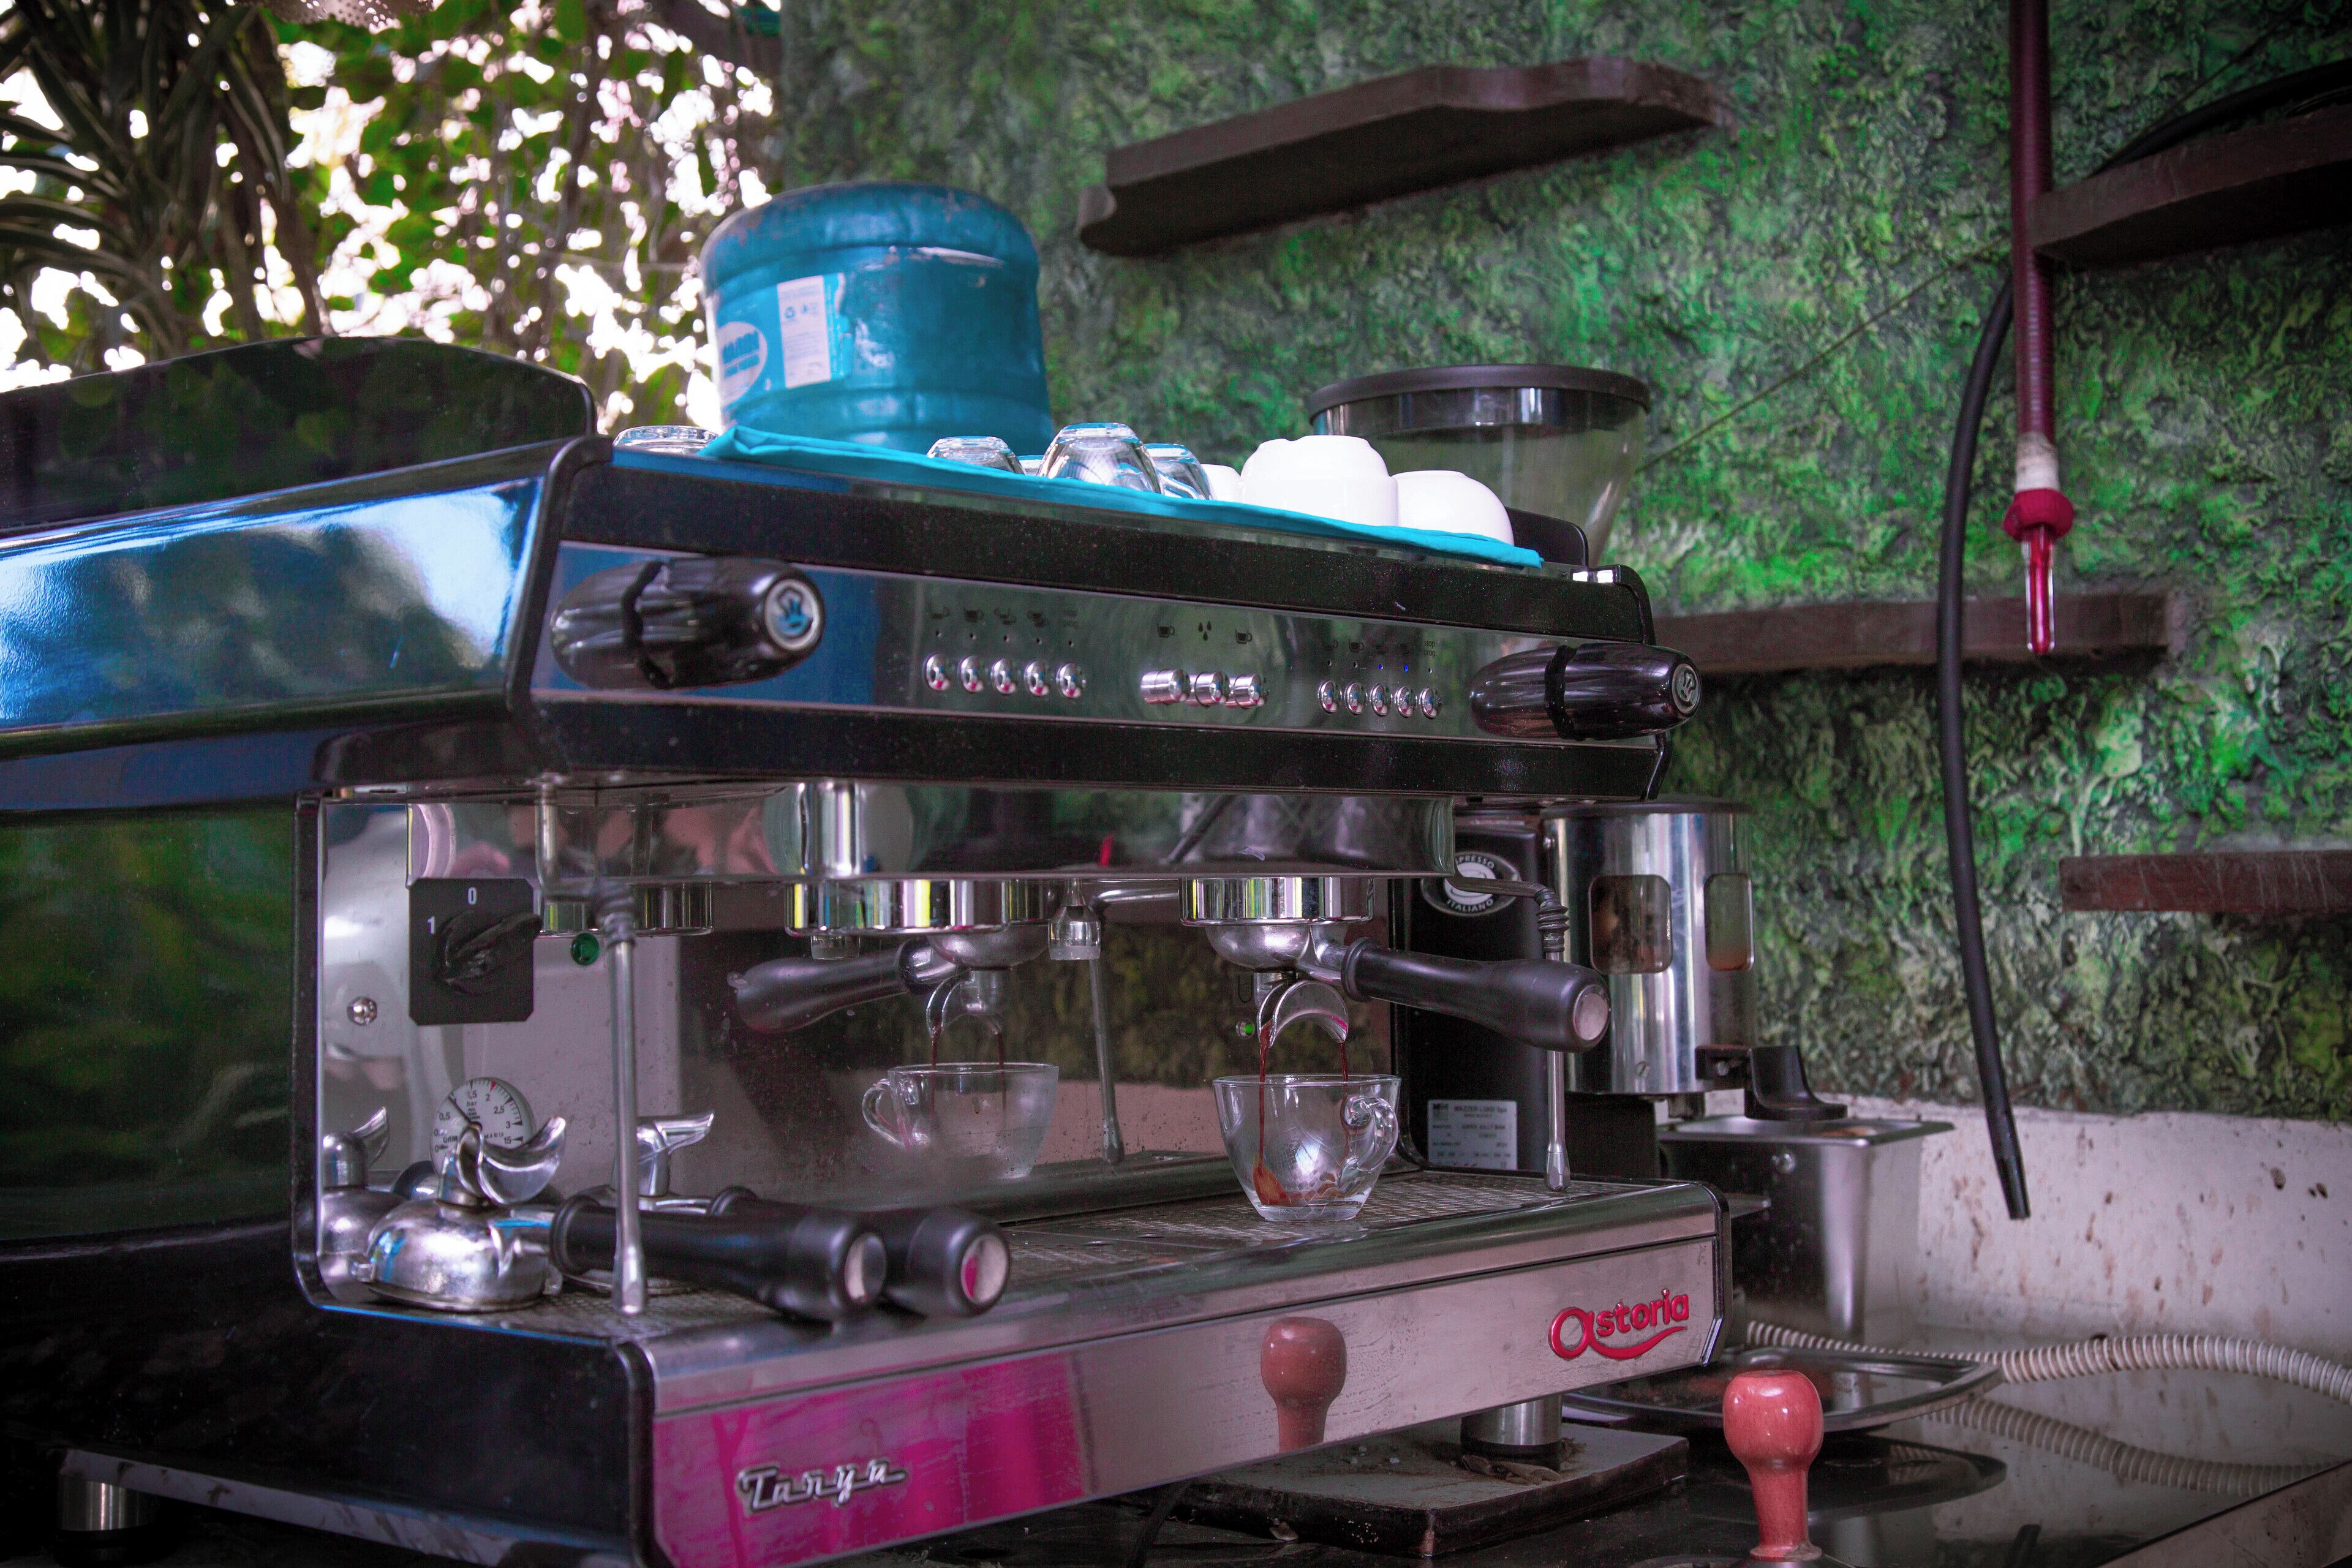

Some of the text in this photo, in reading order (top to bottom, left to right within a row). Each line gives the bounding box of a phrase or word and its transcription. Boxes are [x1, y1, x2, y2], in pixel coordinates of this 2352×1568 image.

[467, 887, 477, 905] 0
[1447, 898, 1494, 912] ITALIANO
[428, 916, 435, 935] 1
